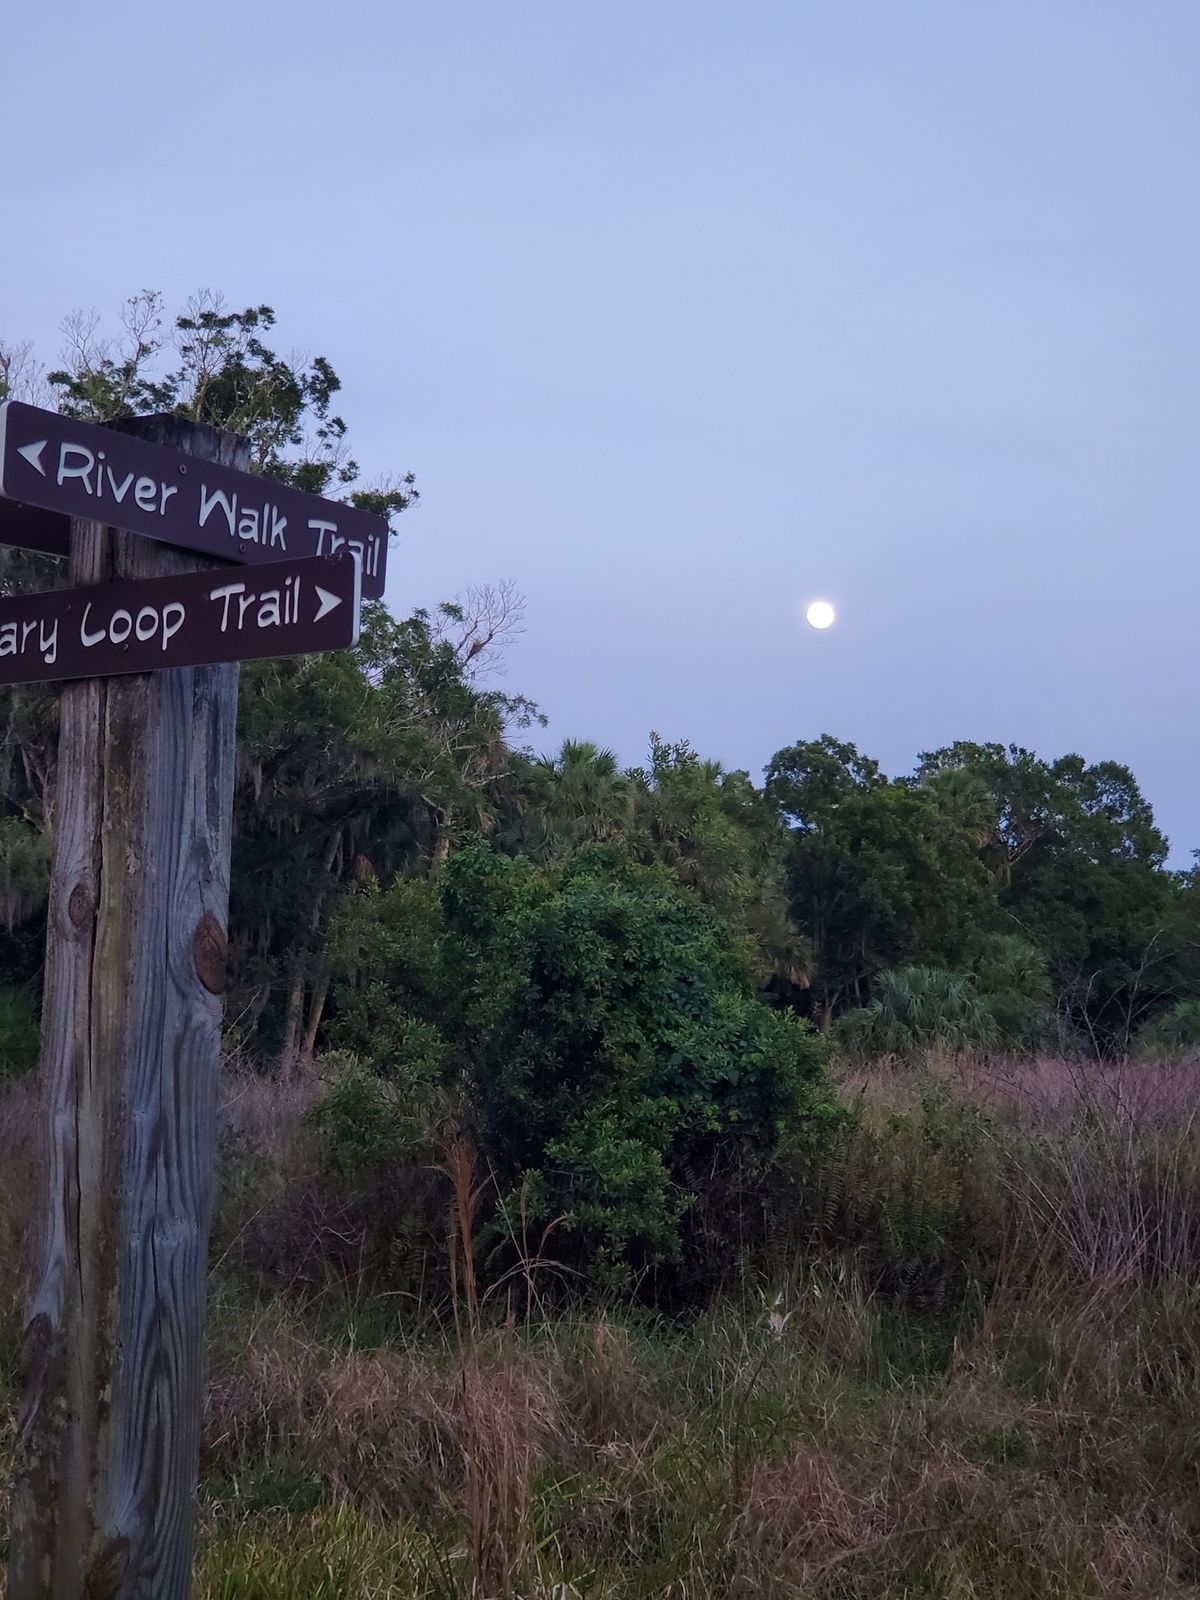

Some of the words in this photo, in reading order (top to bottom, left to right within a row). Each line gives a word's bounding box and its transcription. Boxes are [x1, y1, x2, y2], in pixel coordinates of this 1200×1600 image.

[56, 441, 178, 516] River
[198, 483, 288, 552] Walk
[80, 601, 186, 651] Loop
[209, 576, 301, 633] Trail
